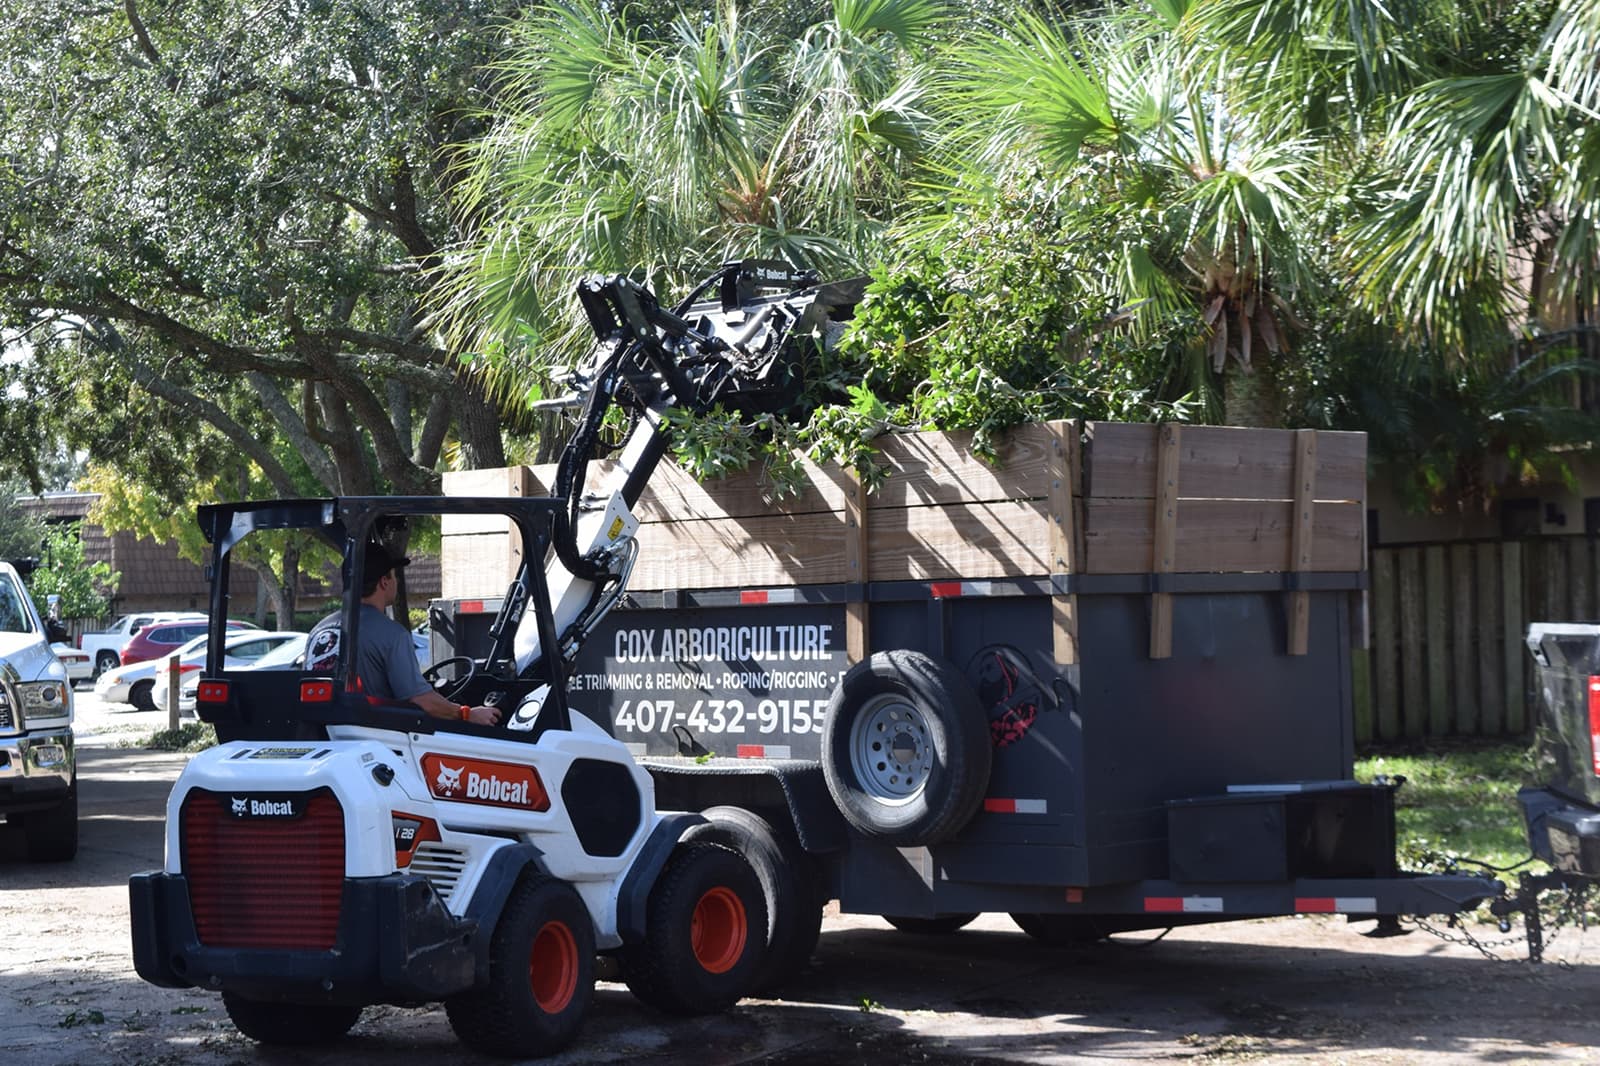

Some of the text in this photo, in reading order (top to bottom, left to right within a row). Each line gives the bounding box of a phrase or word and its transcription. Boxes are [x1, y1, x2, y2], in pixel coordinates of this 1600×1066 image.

[766, 269, 787, 280] Bobcat
[615, 625, 832, 663] COX ARBORICULTURE
[585, 673, 642, 690] TRIMMING
[645, 673, 653, 690] &
[656, 672, 714, 690] REMOVAL
[615, 699, 829, 734] 407-432-9155
[466, 771, 529, 804] Bobcat
[250, 800, 293, 816] Bobcat
